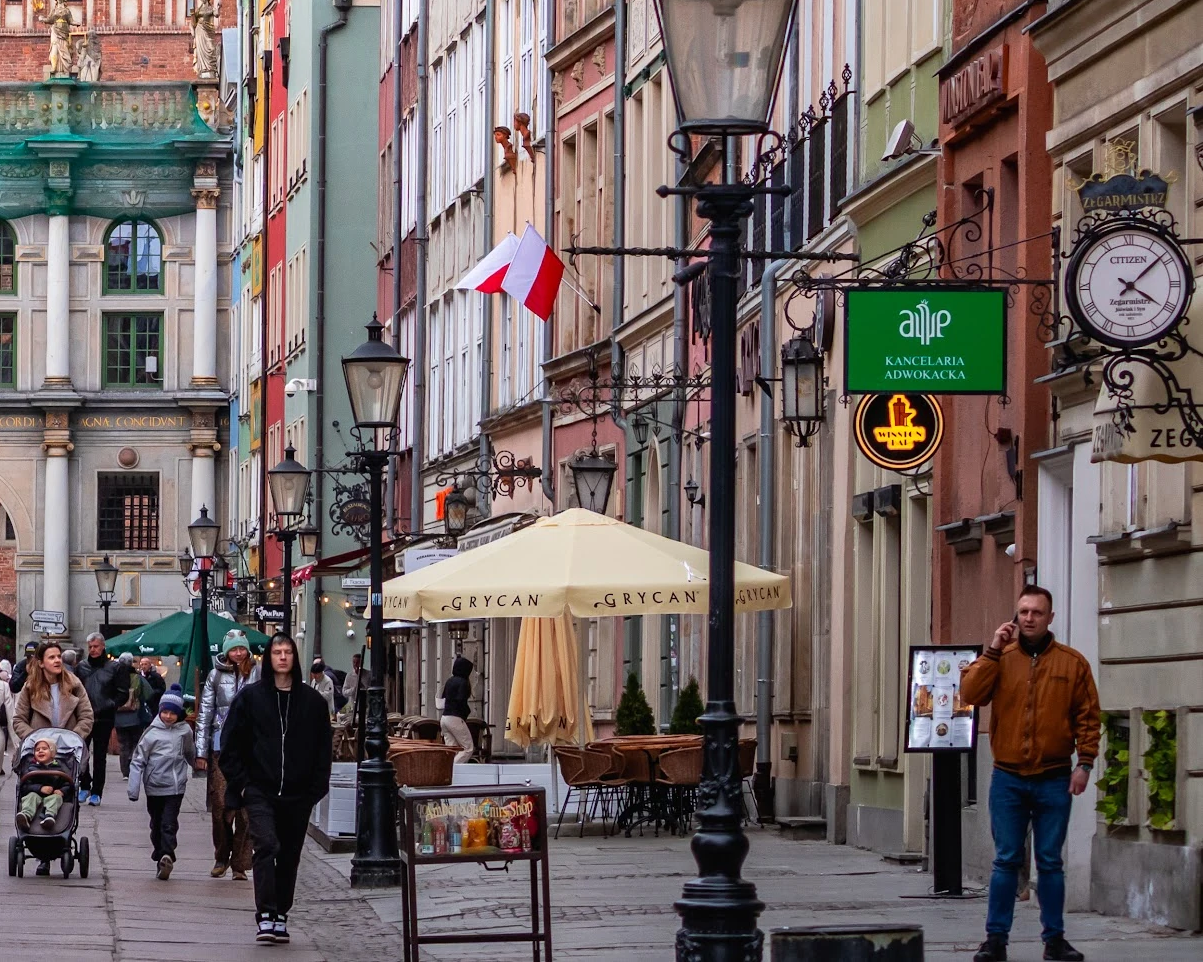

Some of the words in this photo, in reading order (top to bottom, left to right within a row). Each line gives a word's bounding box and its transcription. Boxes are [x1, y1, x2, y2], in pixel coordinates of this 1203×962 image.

[1083, 191, 1166, 209] ZEGARMISTRZ
[1110, 255, 1148, 265] CITIZEN
[1109, 297, 1151, 306] Zegarmistrz
[885, 356, 965, 366] KANCELARIA
[884, 369, 966, 380] ADWOKACKA
[1150, 428, 1193, 448] ZEG
[384, 595, 408, 609] RYCAN
[441, 594, 539, 611] GRYCAN
[594, 590, 697, 608] GRYCAN
[736, 586, 779, 605] GRYCAN
[509, 800, 534, 818] Shop
